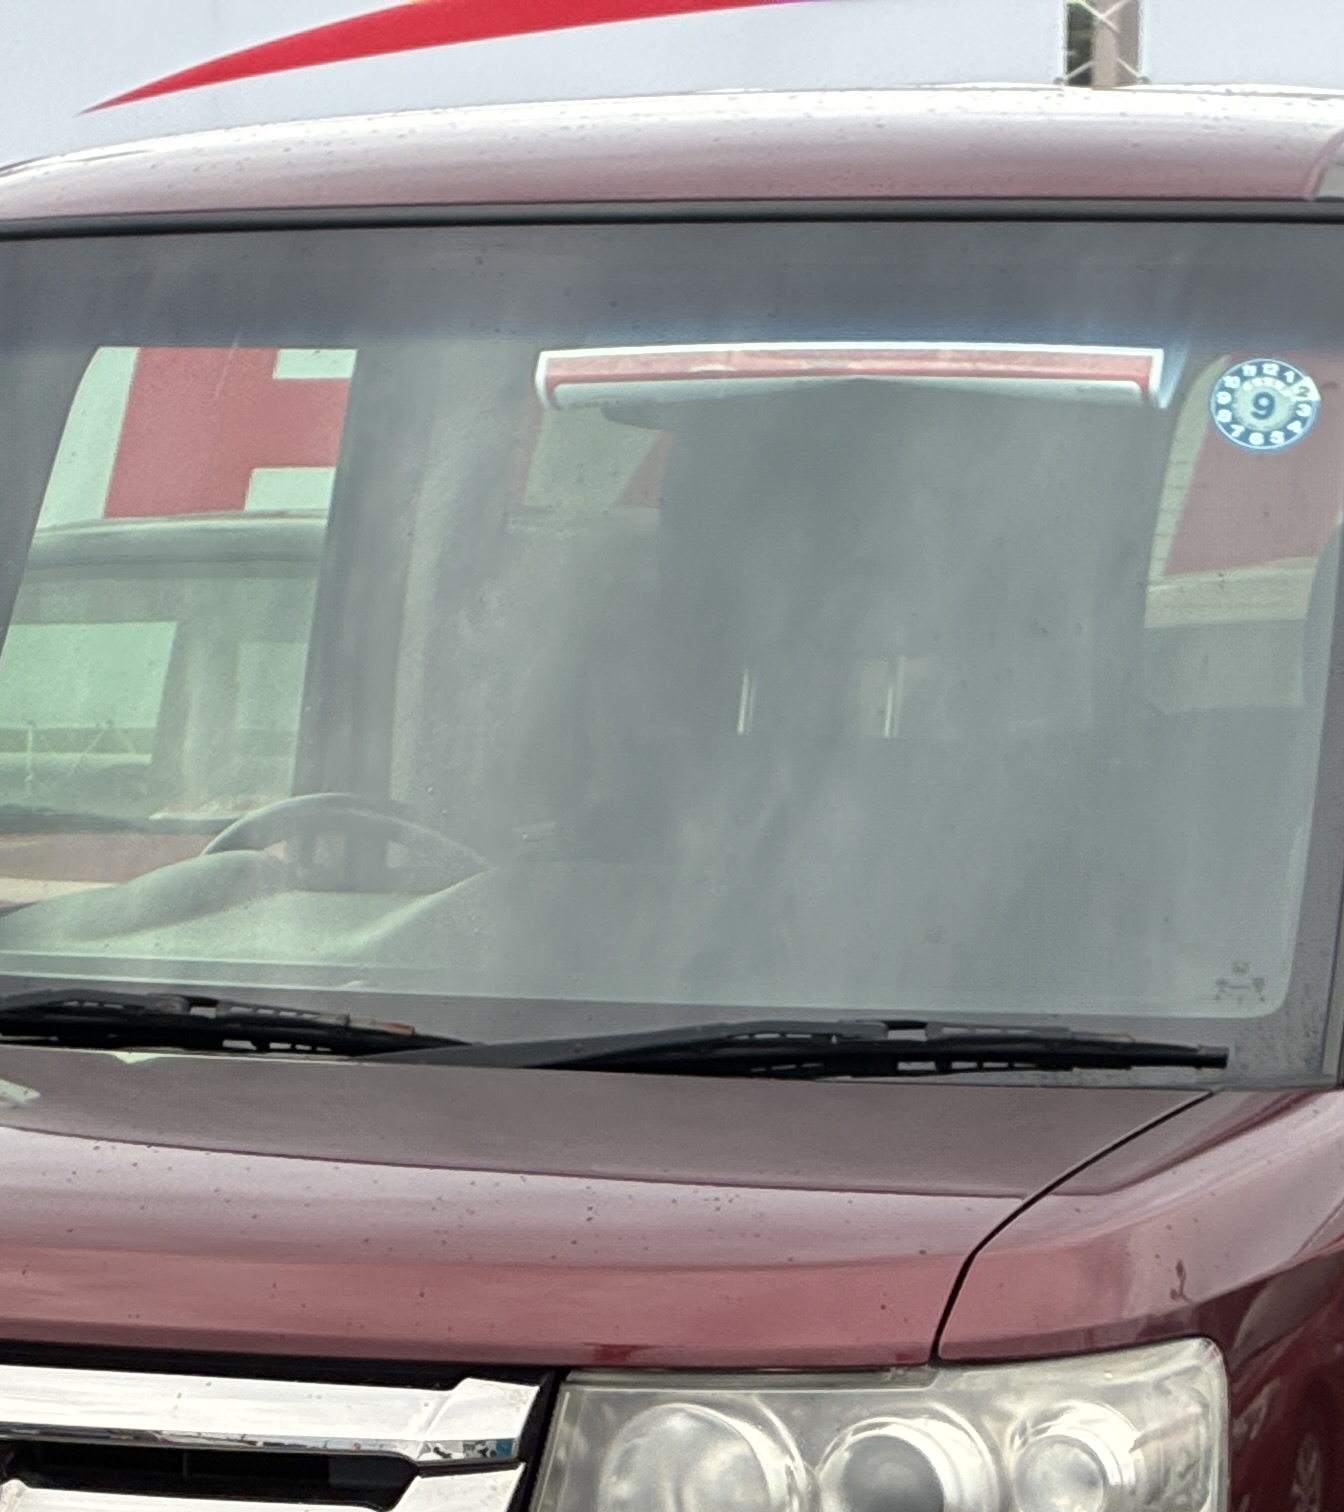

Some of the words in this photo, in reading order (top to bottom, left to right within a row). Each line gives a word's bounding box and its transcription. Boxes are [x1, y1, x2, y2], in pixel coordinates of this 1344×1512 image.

[1284, 371, 1295, 383] 1
[1297, 386, 1310, 397] 2
[1250, 391, 1275, 420] 9
[1295, 403, 1312, 417] 3
[1231, 424, 1244, 437] 7
[1287, 420, 1303, 434] 4
[1249, 432, 1264, 445] 6
